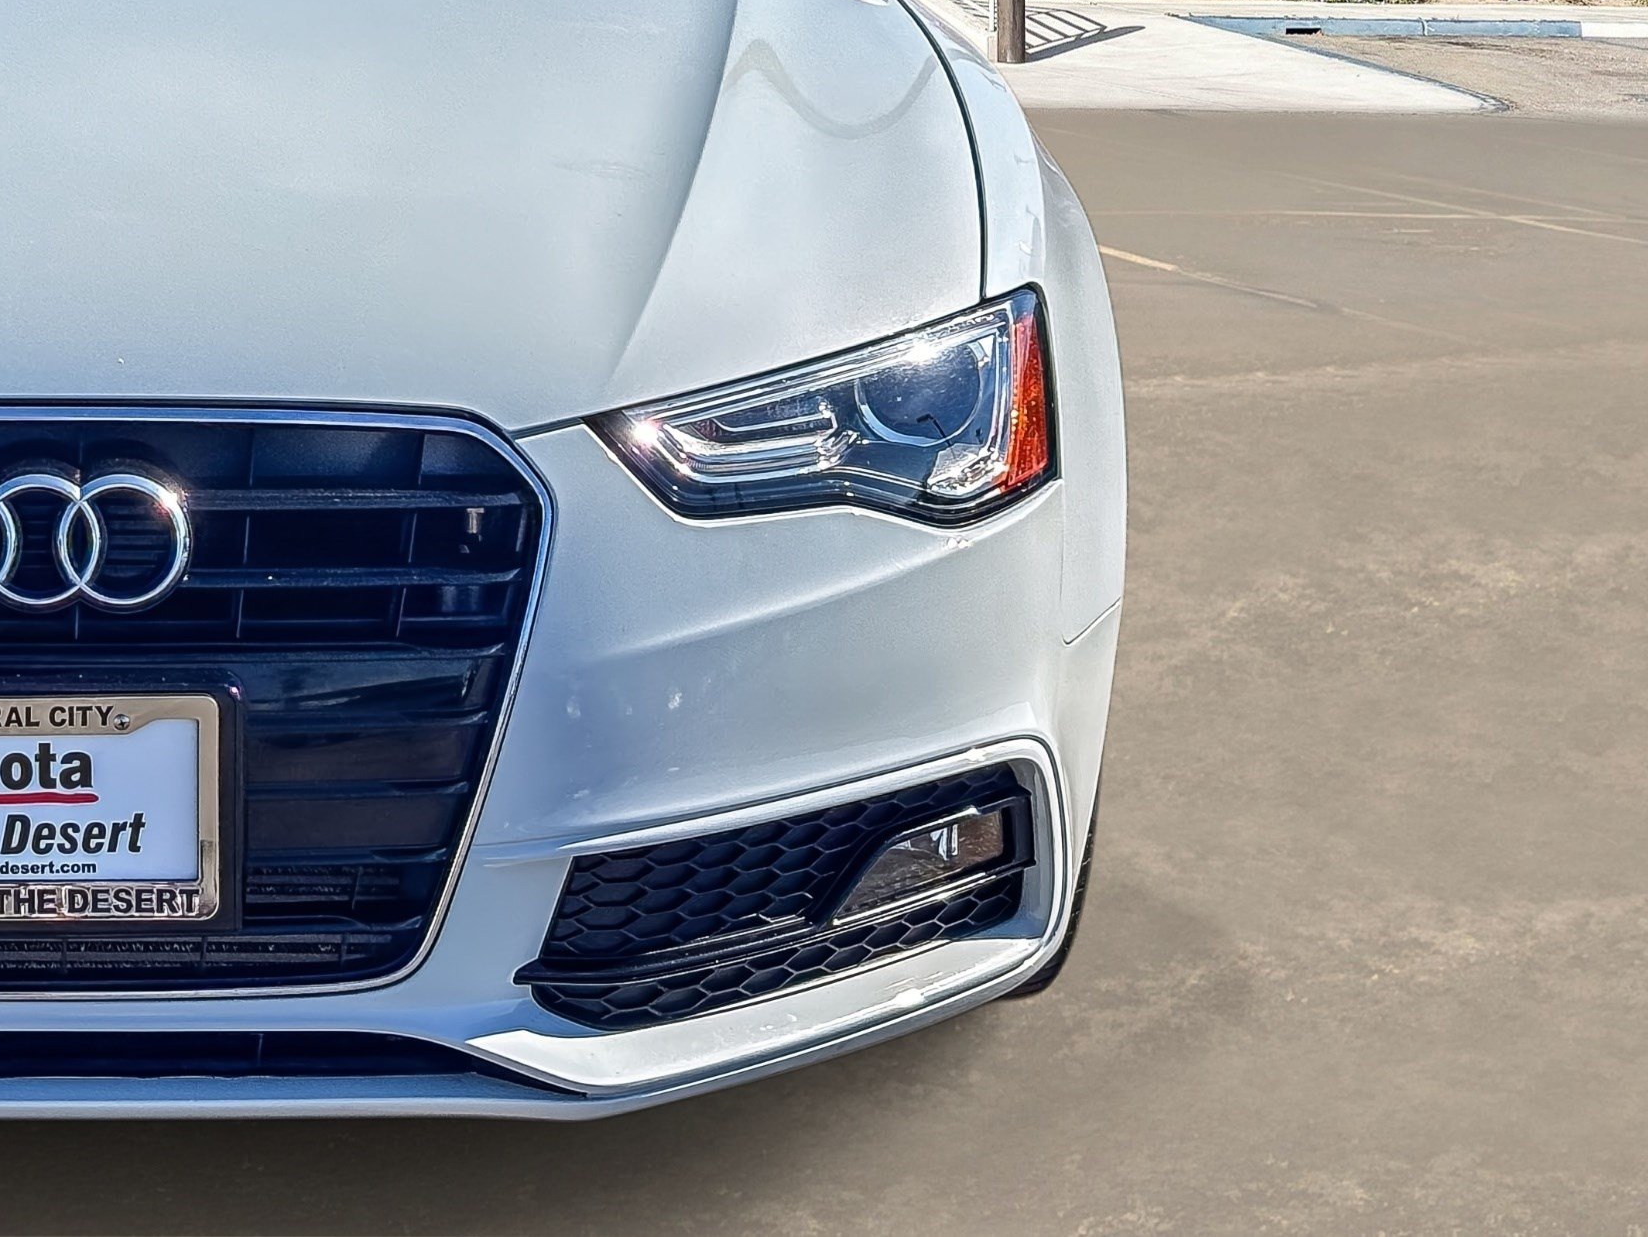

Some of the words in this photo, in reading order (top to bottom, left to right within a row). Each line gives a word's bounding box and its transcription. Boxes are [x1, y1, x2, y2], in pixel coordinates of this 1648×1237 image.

[48, 705, 114, 728] CITY
[0, 812, 147, 855] Desert
[67, 888, 202, 916] DESERT
